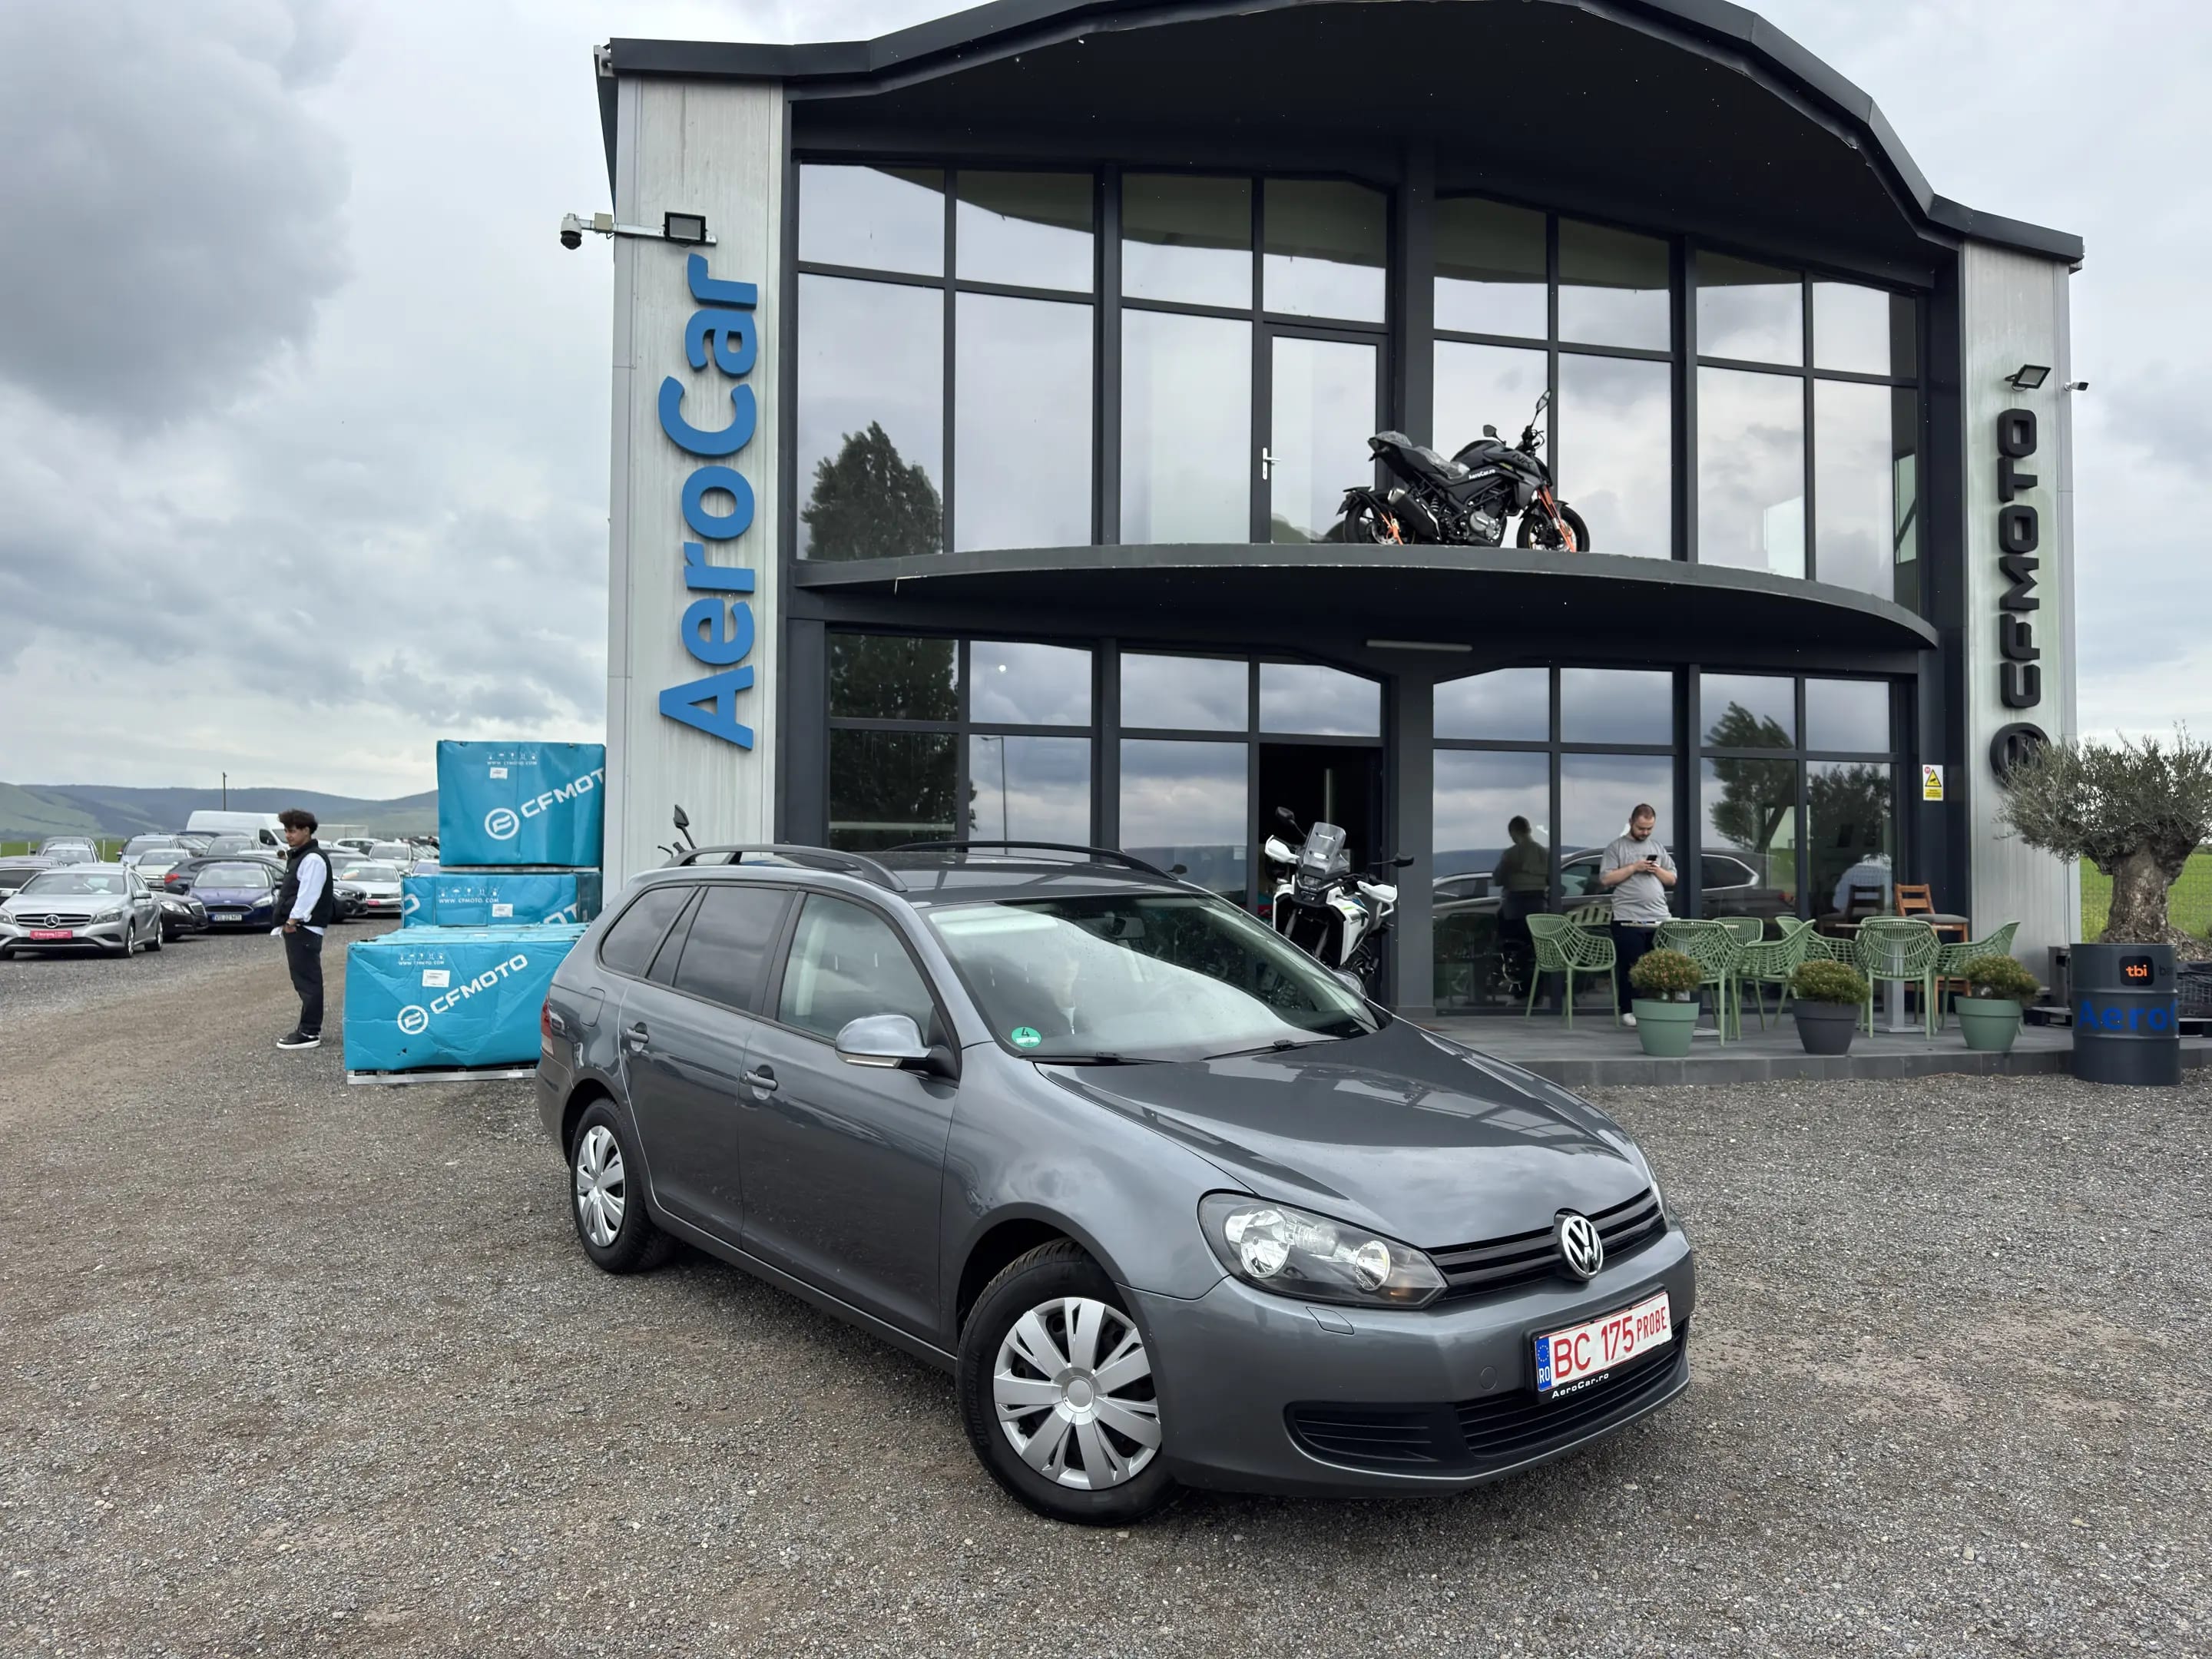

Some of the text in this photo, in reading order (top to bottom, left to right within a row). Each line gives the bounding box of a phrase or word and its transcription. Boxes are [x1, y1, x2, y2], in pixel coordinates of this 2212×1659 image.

[658, 253, 757, 750] AeroCar
[1998, 407, 2041, 708] CFMOTO
[429, 954, 528, 1015] CFMOTO
[2125, 964, 2147, 977] tbi
[1022, 1027, 1030, 1037] 4
[1539, 1306, 1667, 1384] RO BC 175 PROBE
[1551, 1373, 1609, 1399] AeroCar.ro
